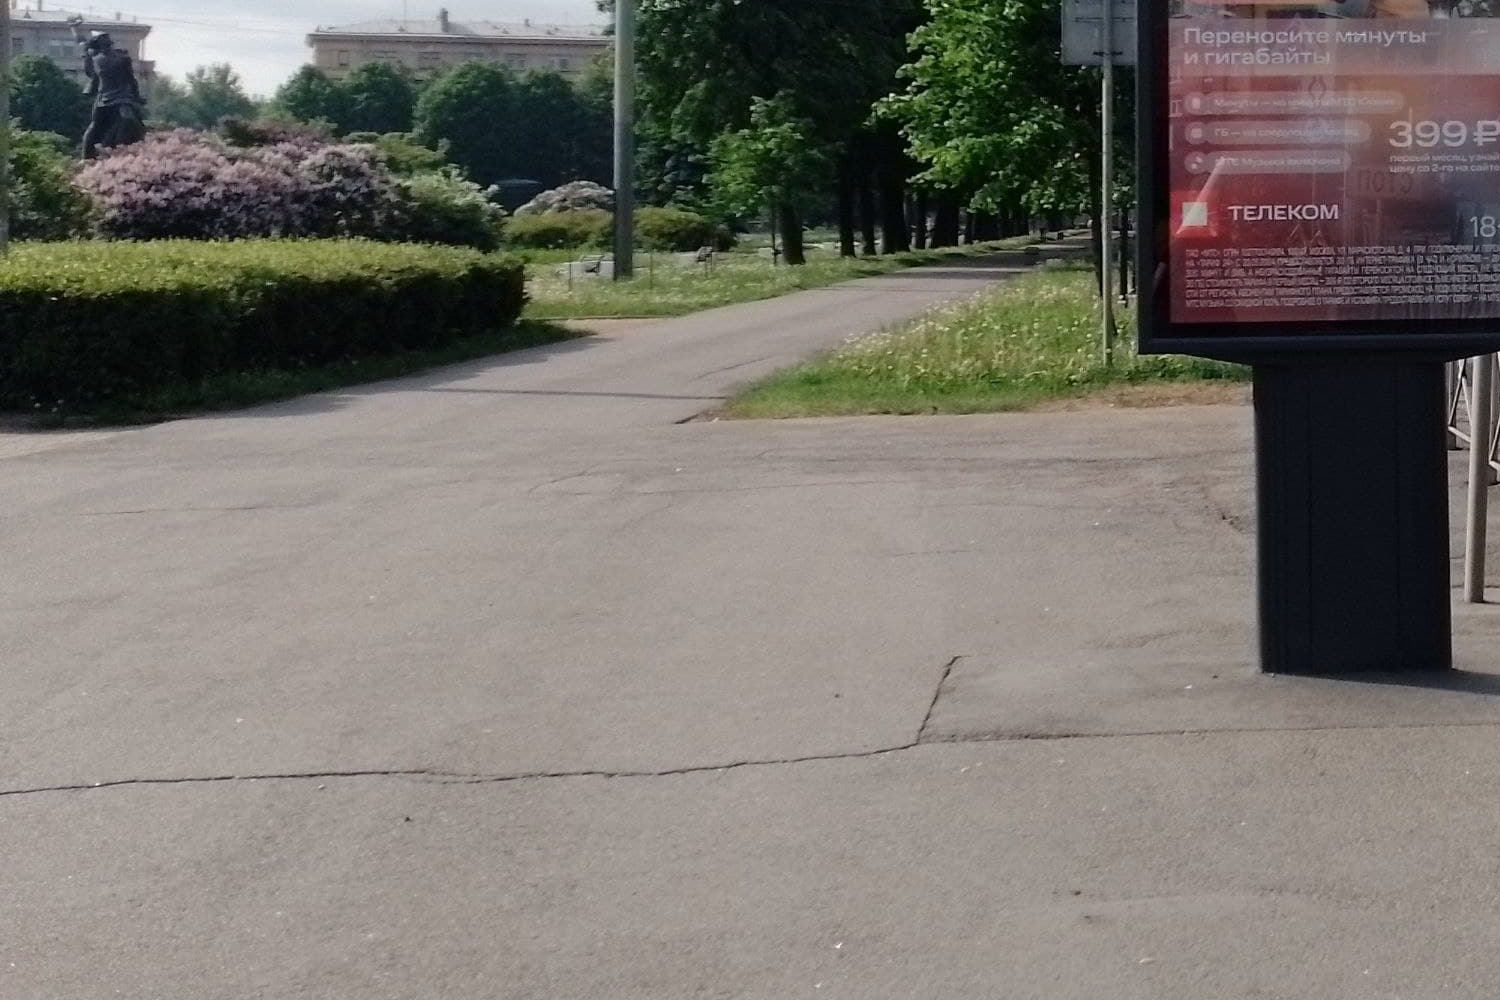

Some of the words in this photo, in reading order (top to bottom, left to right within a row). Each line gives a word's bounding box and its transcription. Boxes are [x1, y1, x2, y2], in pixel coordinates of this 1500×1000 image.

[1184, 27, 1329, 46] Переносите
[1335, 30, 1426, 47] минуты
[1184, 52, 1198, 65] и
[1204, 46, 1330, 66] гигабайты
[1389, 120, 1468, 148] 399
[1389, 153, 1430, 163] первый
[1470, 163, 1500, 172] сайте
[1227, 204, 1339, 221] ТЕЛЕКОМ
